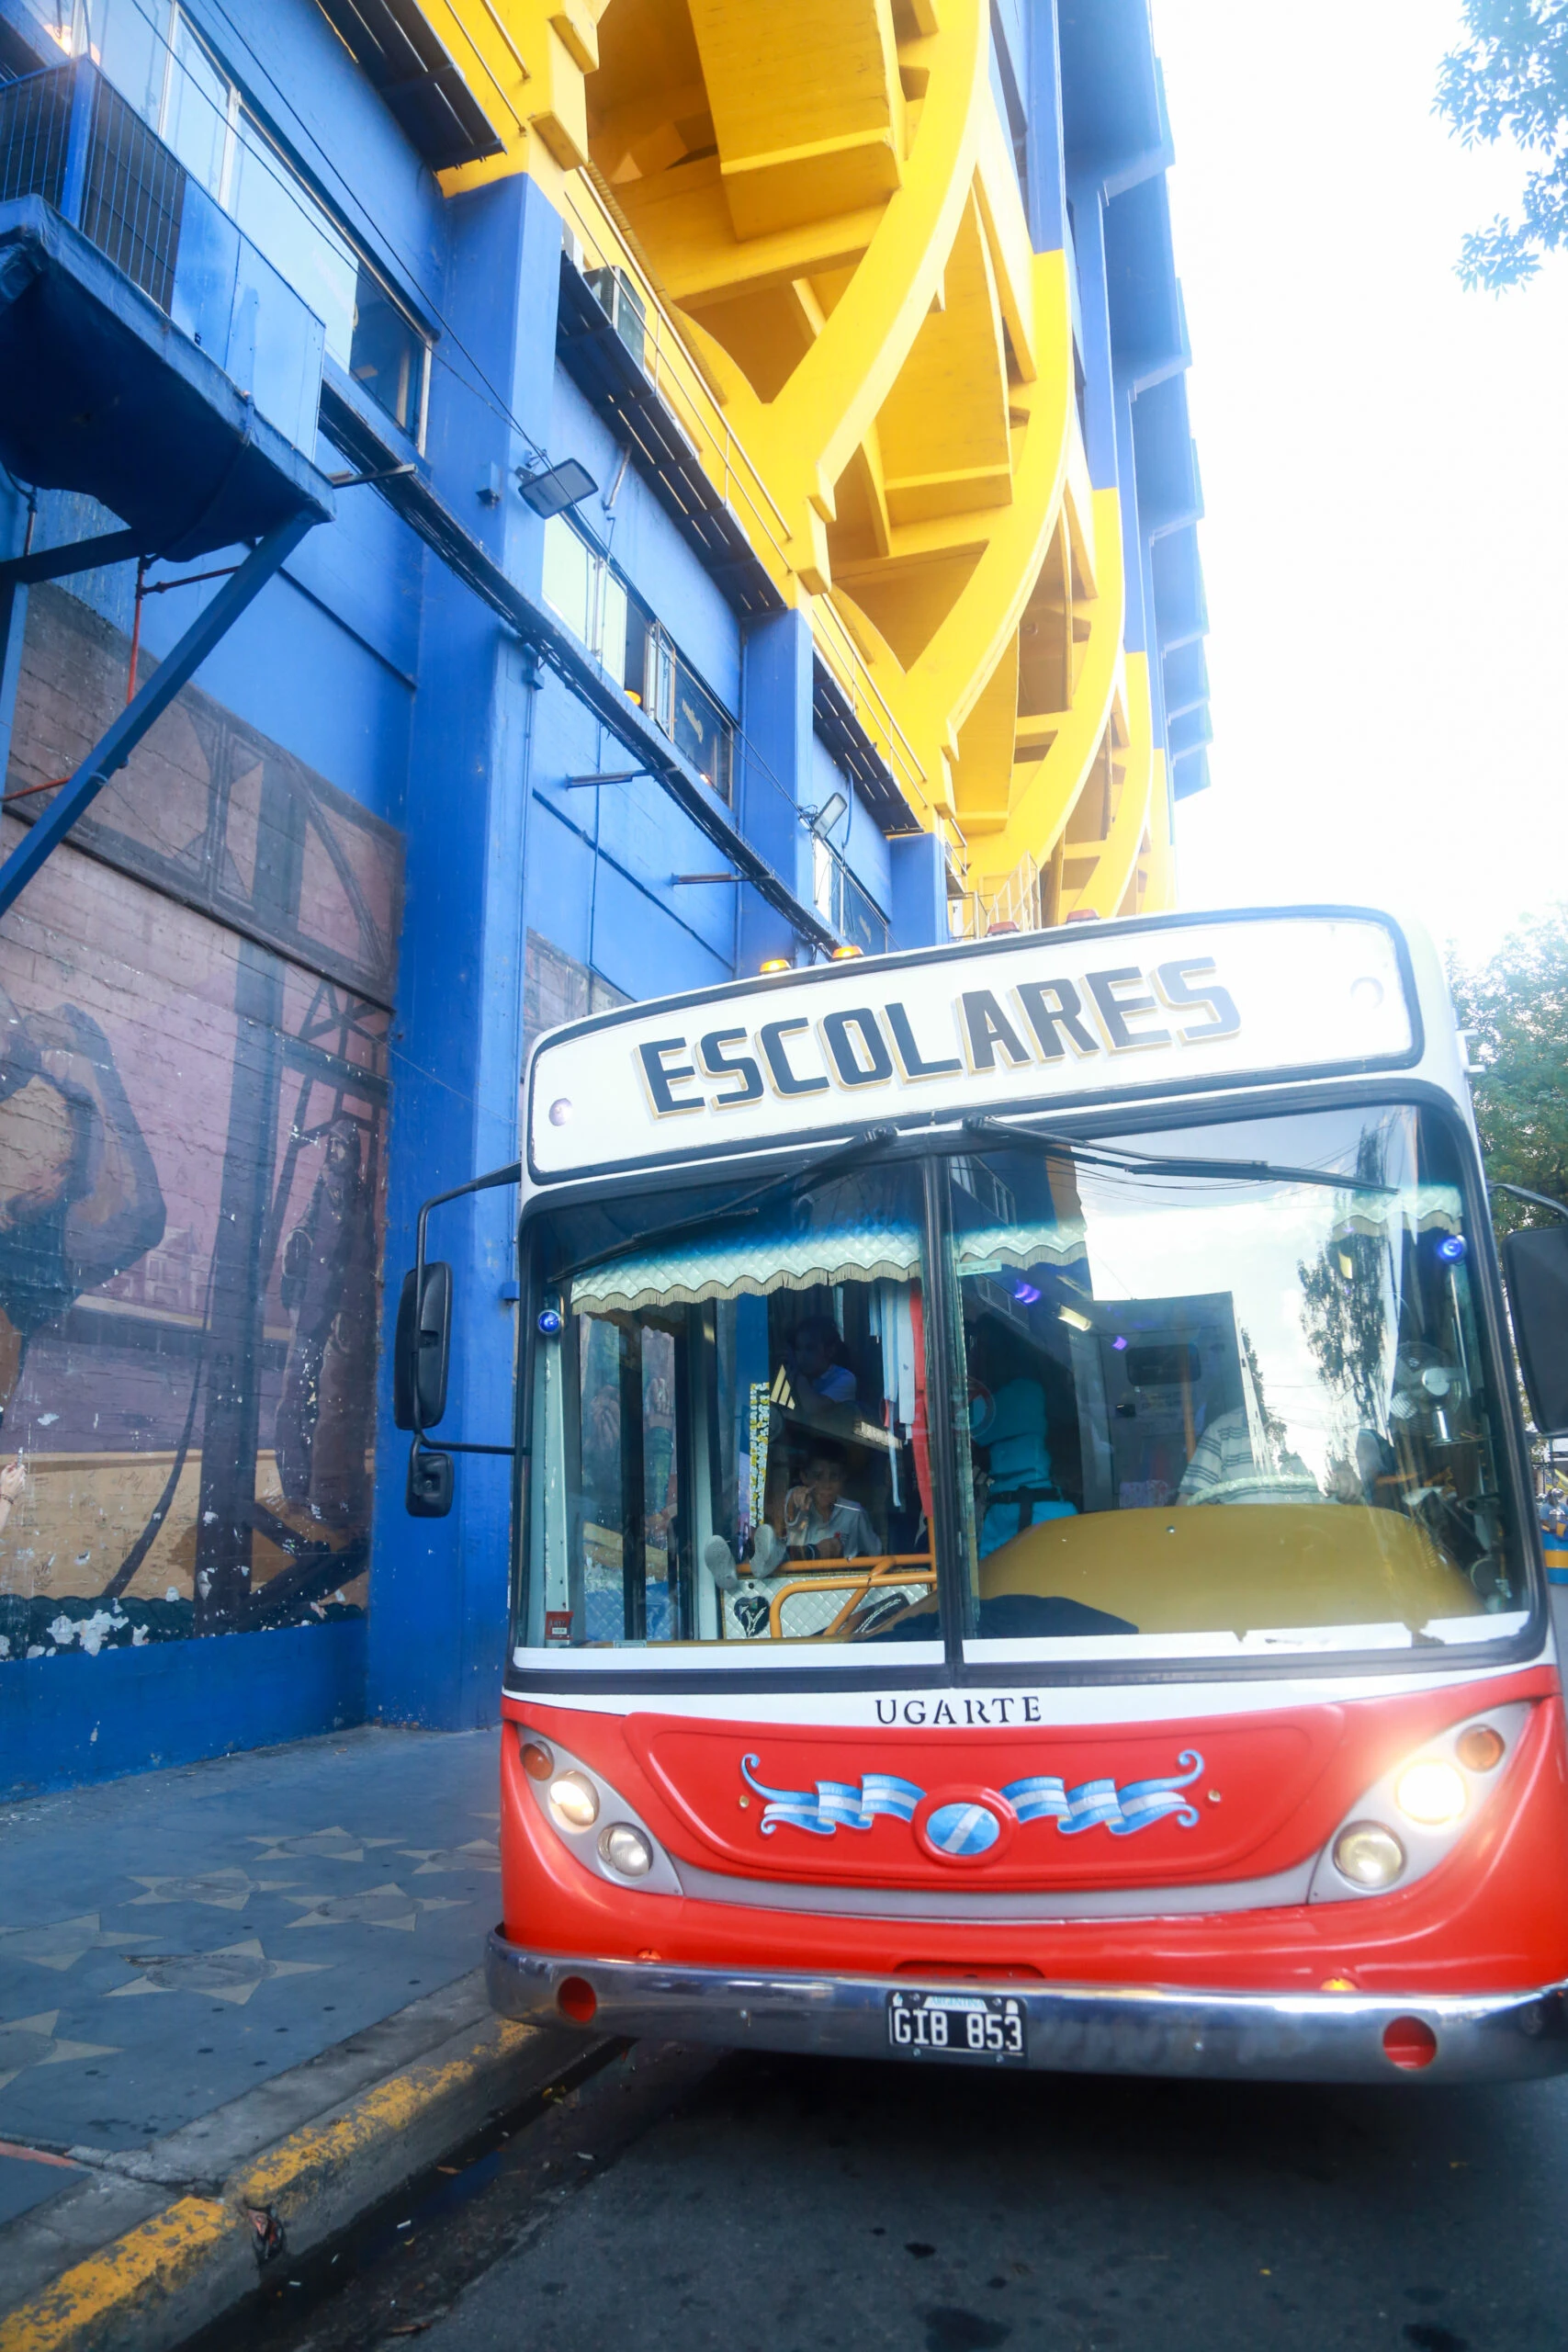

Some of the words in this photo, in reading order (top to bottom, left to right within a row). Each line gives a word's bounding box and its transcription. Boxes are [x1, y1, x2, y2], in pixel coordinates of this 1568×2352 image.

[636, 956, 1241, 1120] ESCOLARES
[875, 1696, 1042, 1724] UGARTE
[894, 2008, 948, 2046] GIB
[966, 2013, 1022, 2051] 853
